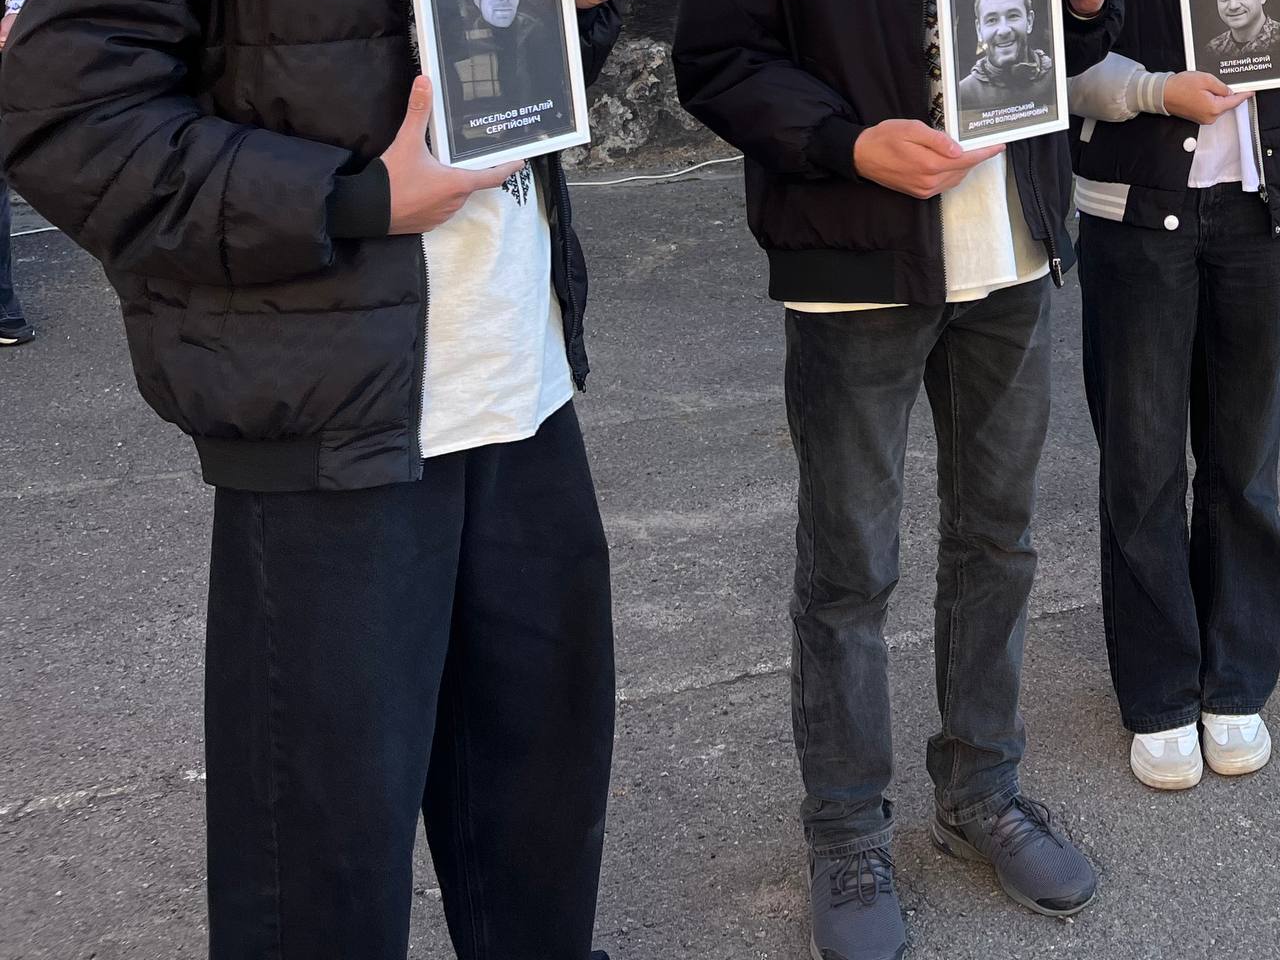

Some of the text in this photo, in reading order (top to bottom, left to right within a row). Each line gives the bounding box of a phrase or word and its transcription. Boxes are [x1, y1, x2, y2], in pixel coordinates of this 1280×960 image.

[1219, 63, 1272, 74] МИКОЛАЙОВИЧ
[1220, 55, 1271, 67] ЗЕЛЕНИЙ ЮРІЙ
[470, 100, 553, 128] КИСЕЛЬОВ ВІТАЛІЙ
[968, 106, 1049, 130] ДМИТРО ВОЛОДИМИРОВИЧ
[982, 101, 1034, 118] МАРТИНОВСЬКИЙ
[486, 114, 541, 135] СЕРГІЙОВИЧ
